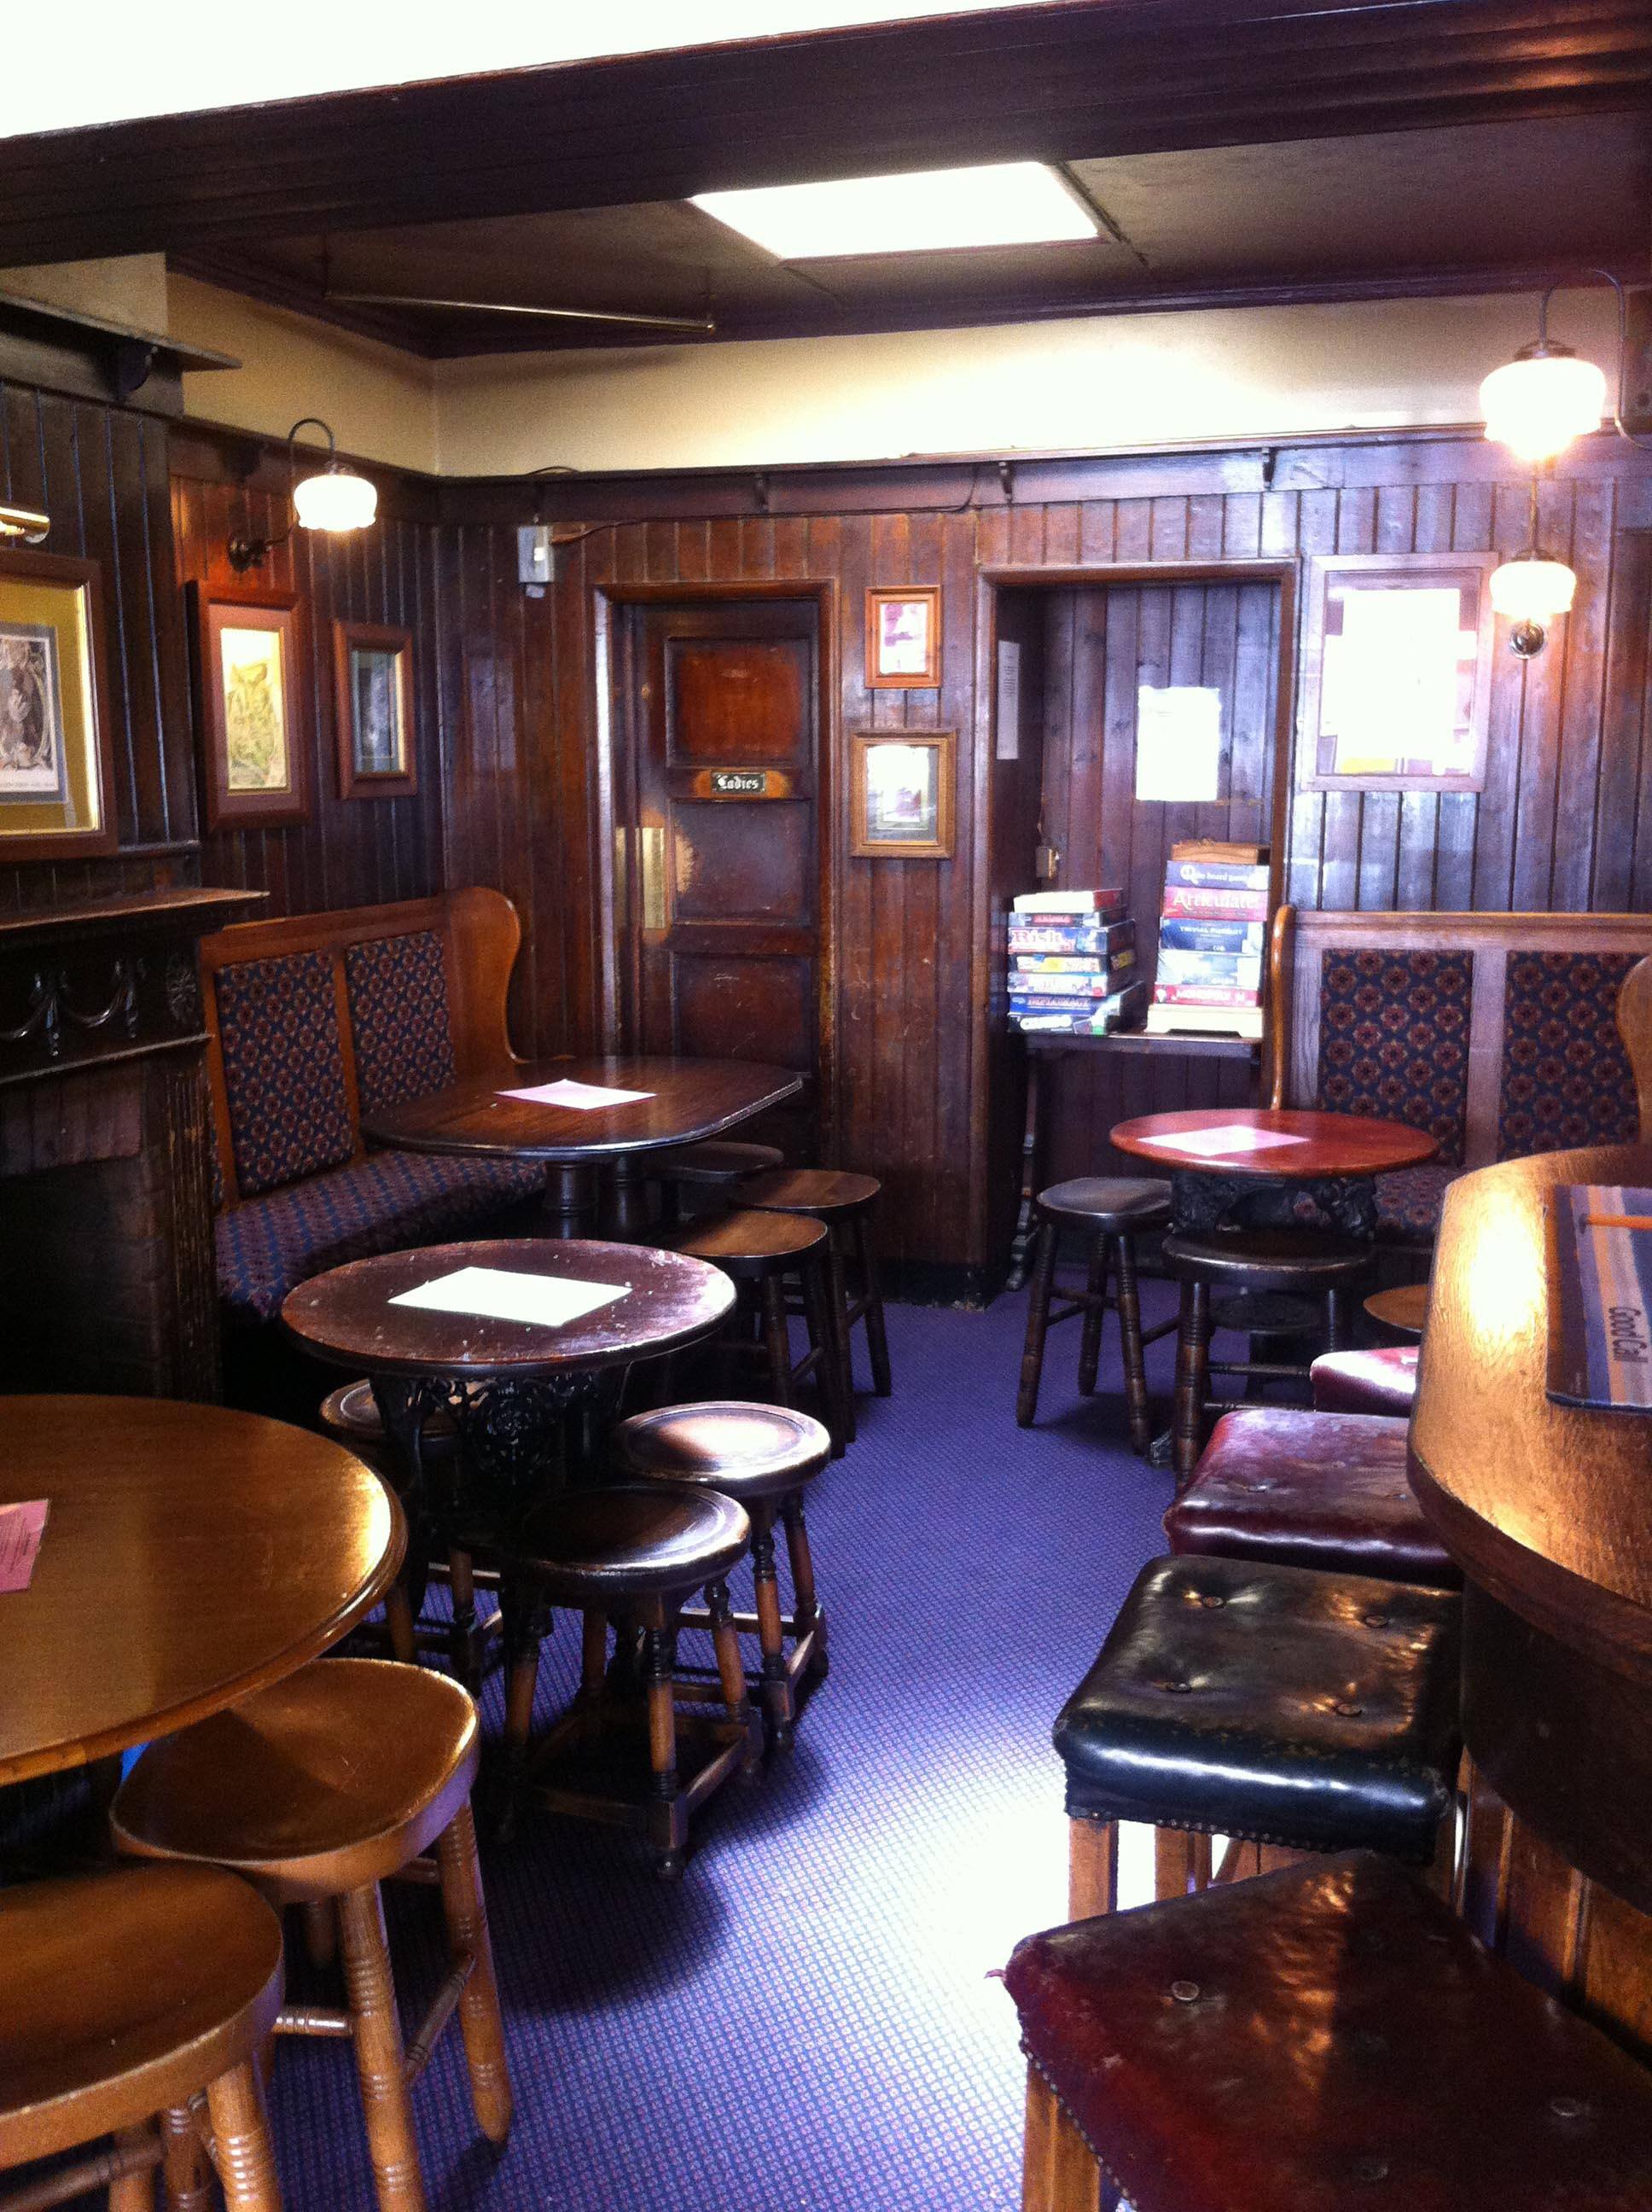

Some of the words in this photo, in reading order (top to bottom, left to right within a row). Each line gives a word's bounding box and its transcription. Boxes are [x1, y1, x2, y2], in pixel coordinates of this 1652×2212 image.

[717, 775, 759, 789] Ladies
[1012, 930, 1062, 943] Risk
[1179, 927, 1209, 935] TRIVIAL
[1210, 927, 1243, 936] PURSUIT
